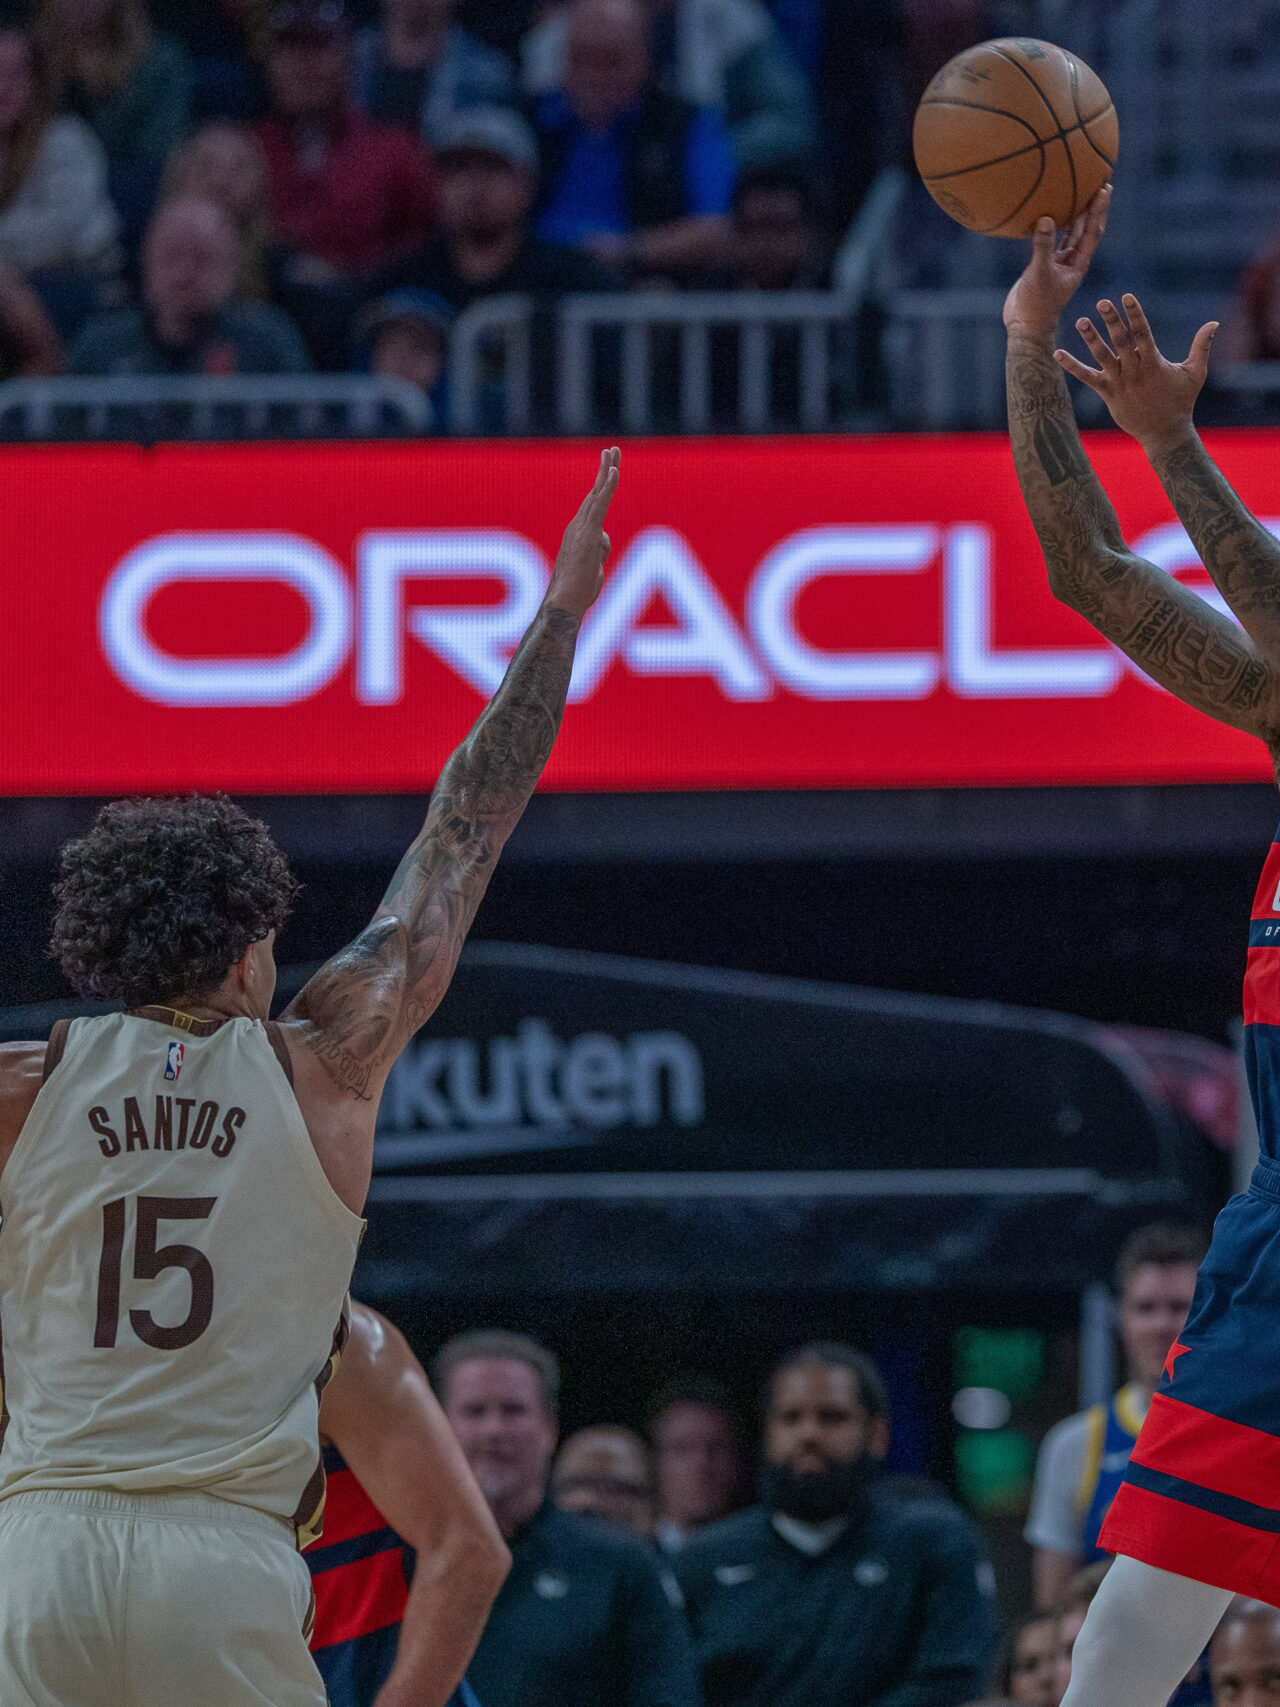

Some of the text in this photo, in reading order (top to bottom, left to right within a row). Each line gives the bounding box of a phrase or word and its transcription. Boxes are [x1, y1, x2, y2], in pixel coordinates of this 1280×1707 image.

[1265, 926, 1280, 936] OF
[390, 1016, 704, 1128] kuten
[88, 1095, 246, 1158] SANTOS
[94, 1196, 218, 1350] 15
